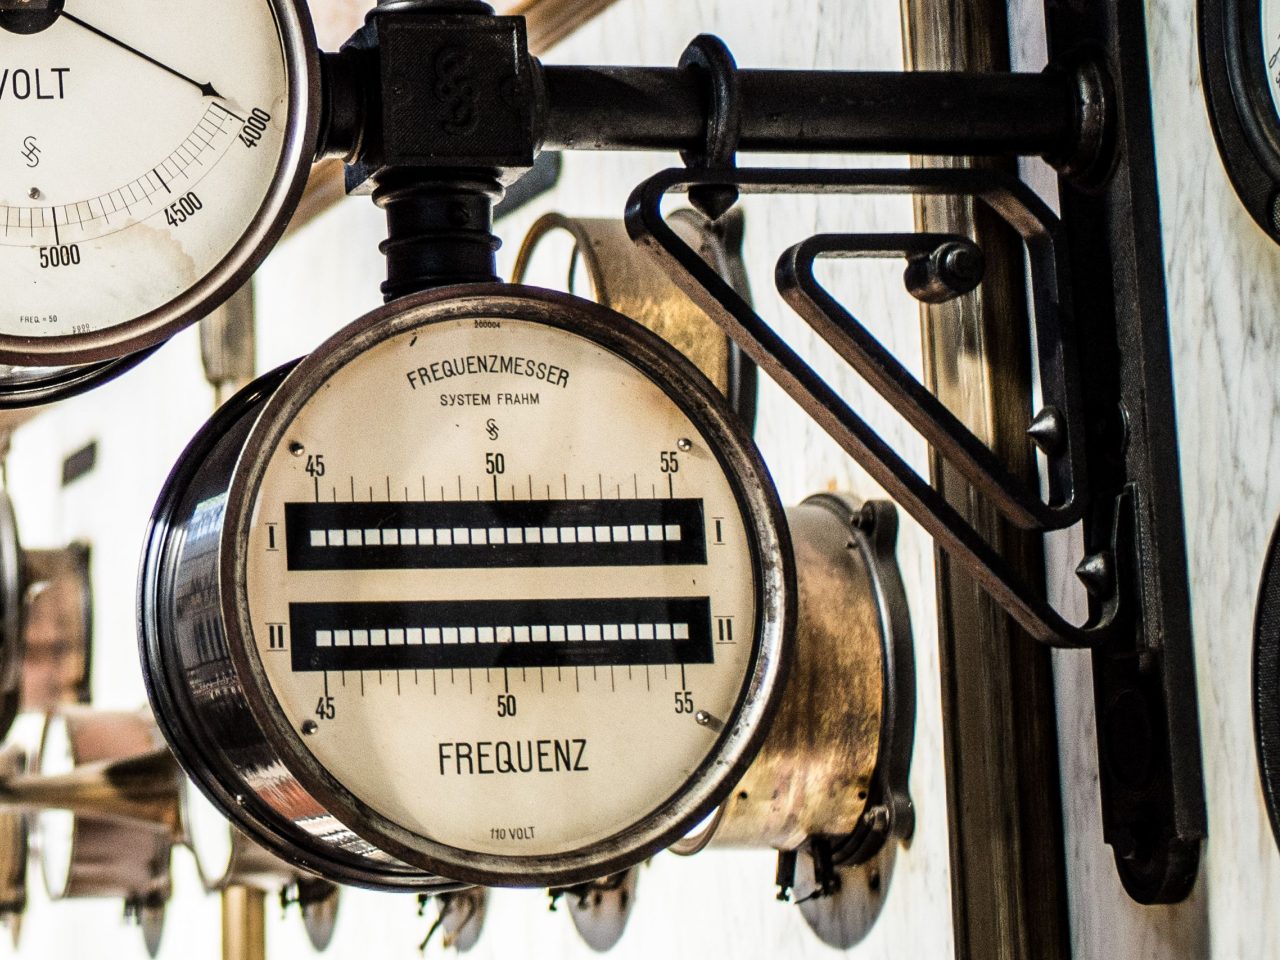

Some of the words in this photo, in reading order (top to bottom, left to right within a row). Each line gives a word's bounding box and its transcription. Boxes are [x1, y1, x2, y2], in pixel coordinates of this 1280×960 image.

[238, 107, 272, 148] 4000
[163, 191, 203, 227] 4500
[39, 243, 81, 269] 5000
[48, 314, 58, 322] 50
[406, 354, 570, 390] FREQUENZMESSER
[440, 393, 491, 406] SYSTEM
[497, 392, 540, 405] FRAHM
[305, 454, 326, 477] 45
[485, 452, 505, 474] 50
[660, 450, 679, 473] 55
[315, 696, 336, 720] 45
[497, 694, 517, 718] 50
[674, 691, 694, 714] 55
[438, 738, 589, 776] FREQUENZ
[490, 828, 506, 840] 110
[508, 826, 535, 840] VOLT
